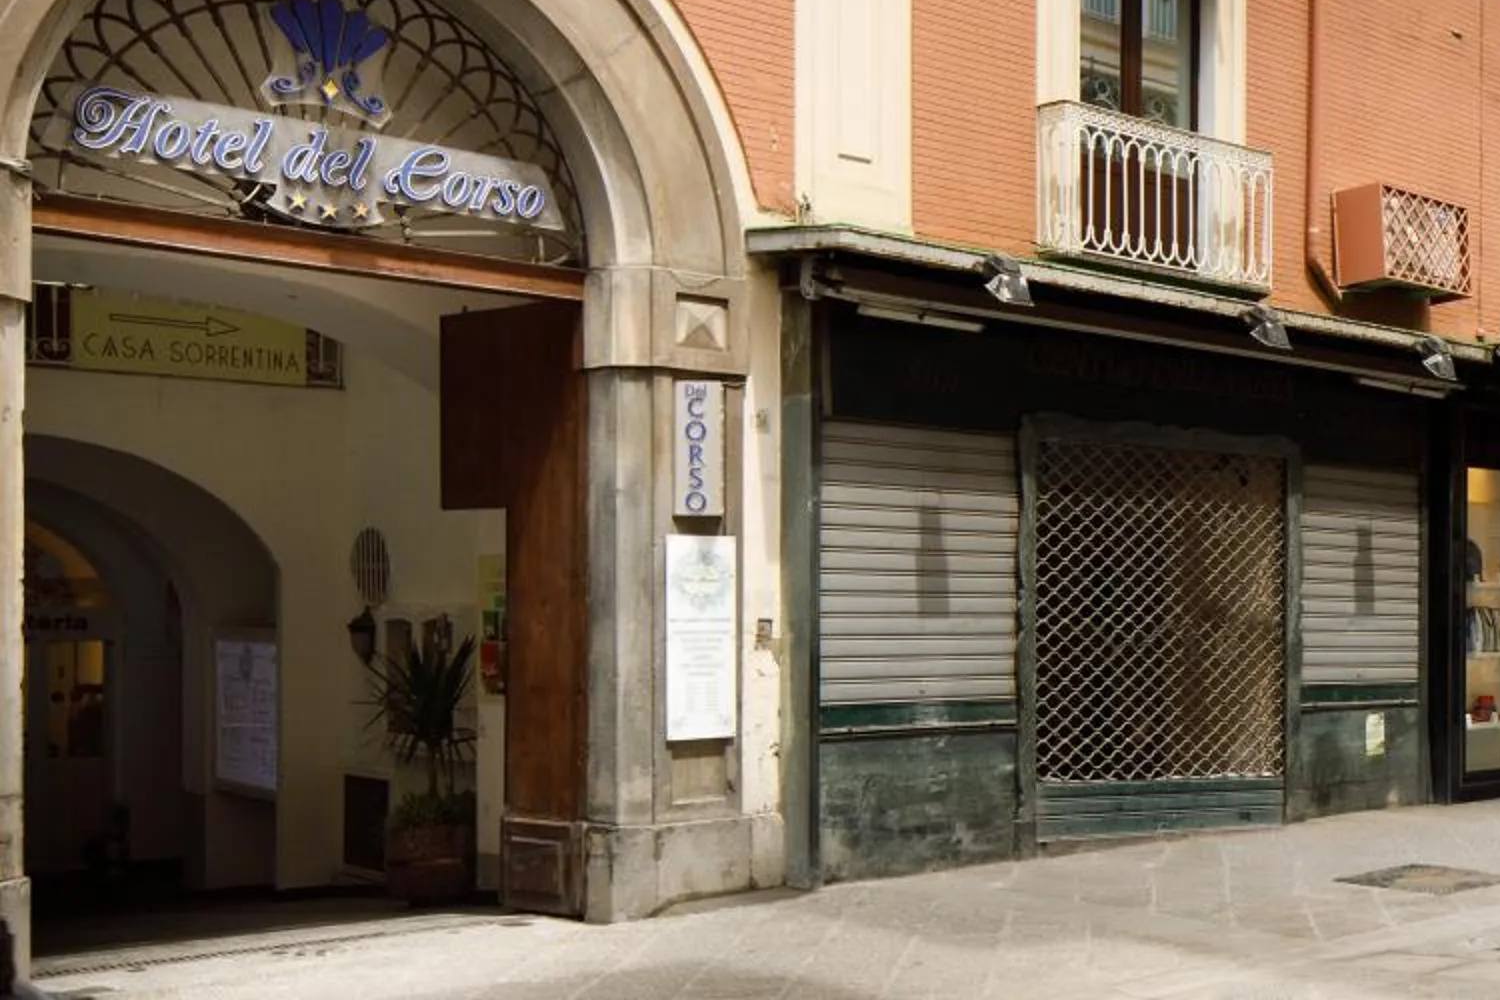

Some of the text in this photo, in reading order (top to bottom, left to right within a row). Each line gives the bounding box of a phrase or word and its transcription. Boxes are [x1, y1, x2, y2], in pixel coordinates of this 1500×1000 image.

[73, 87, 545, 218] Hotel del Corso
[82, 332, 300, 372] CASA SORRENTINA
[685, 397, 707, 512] CORSO
